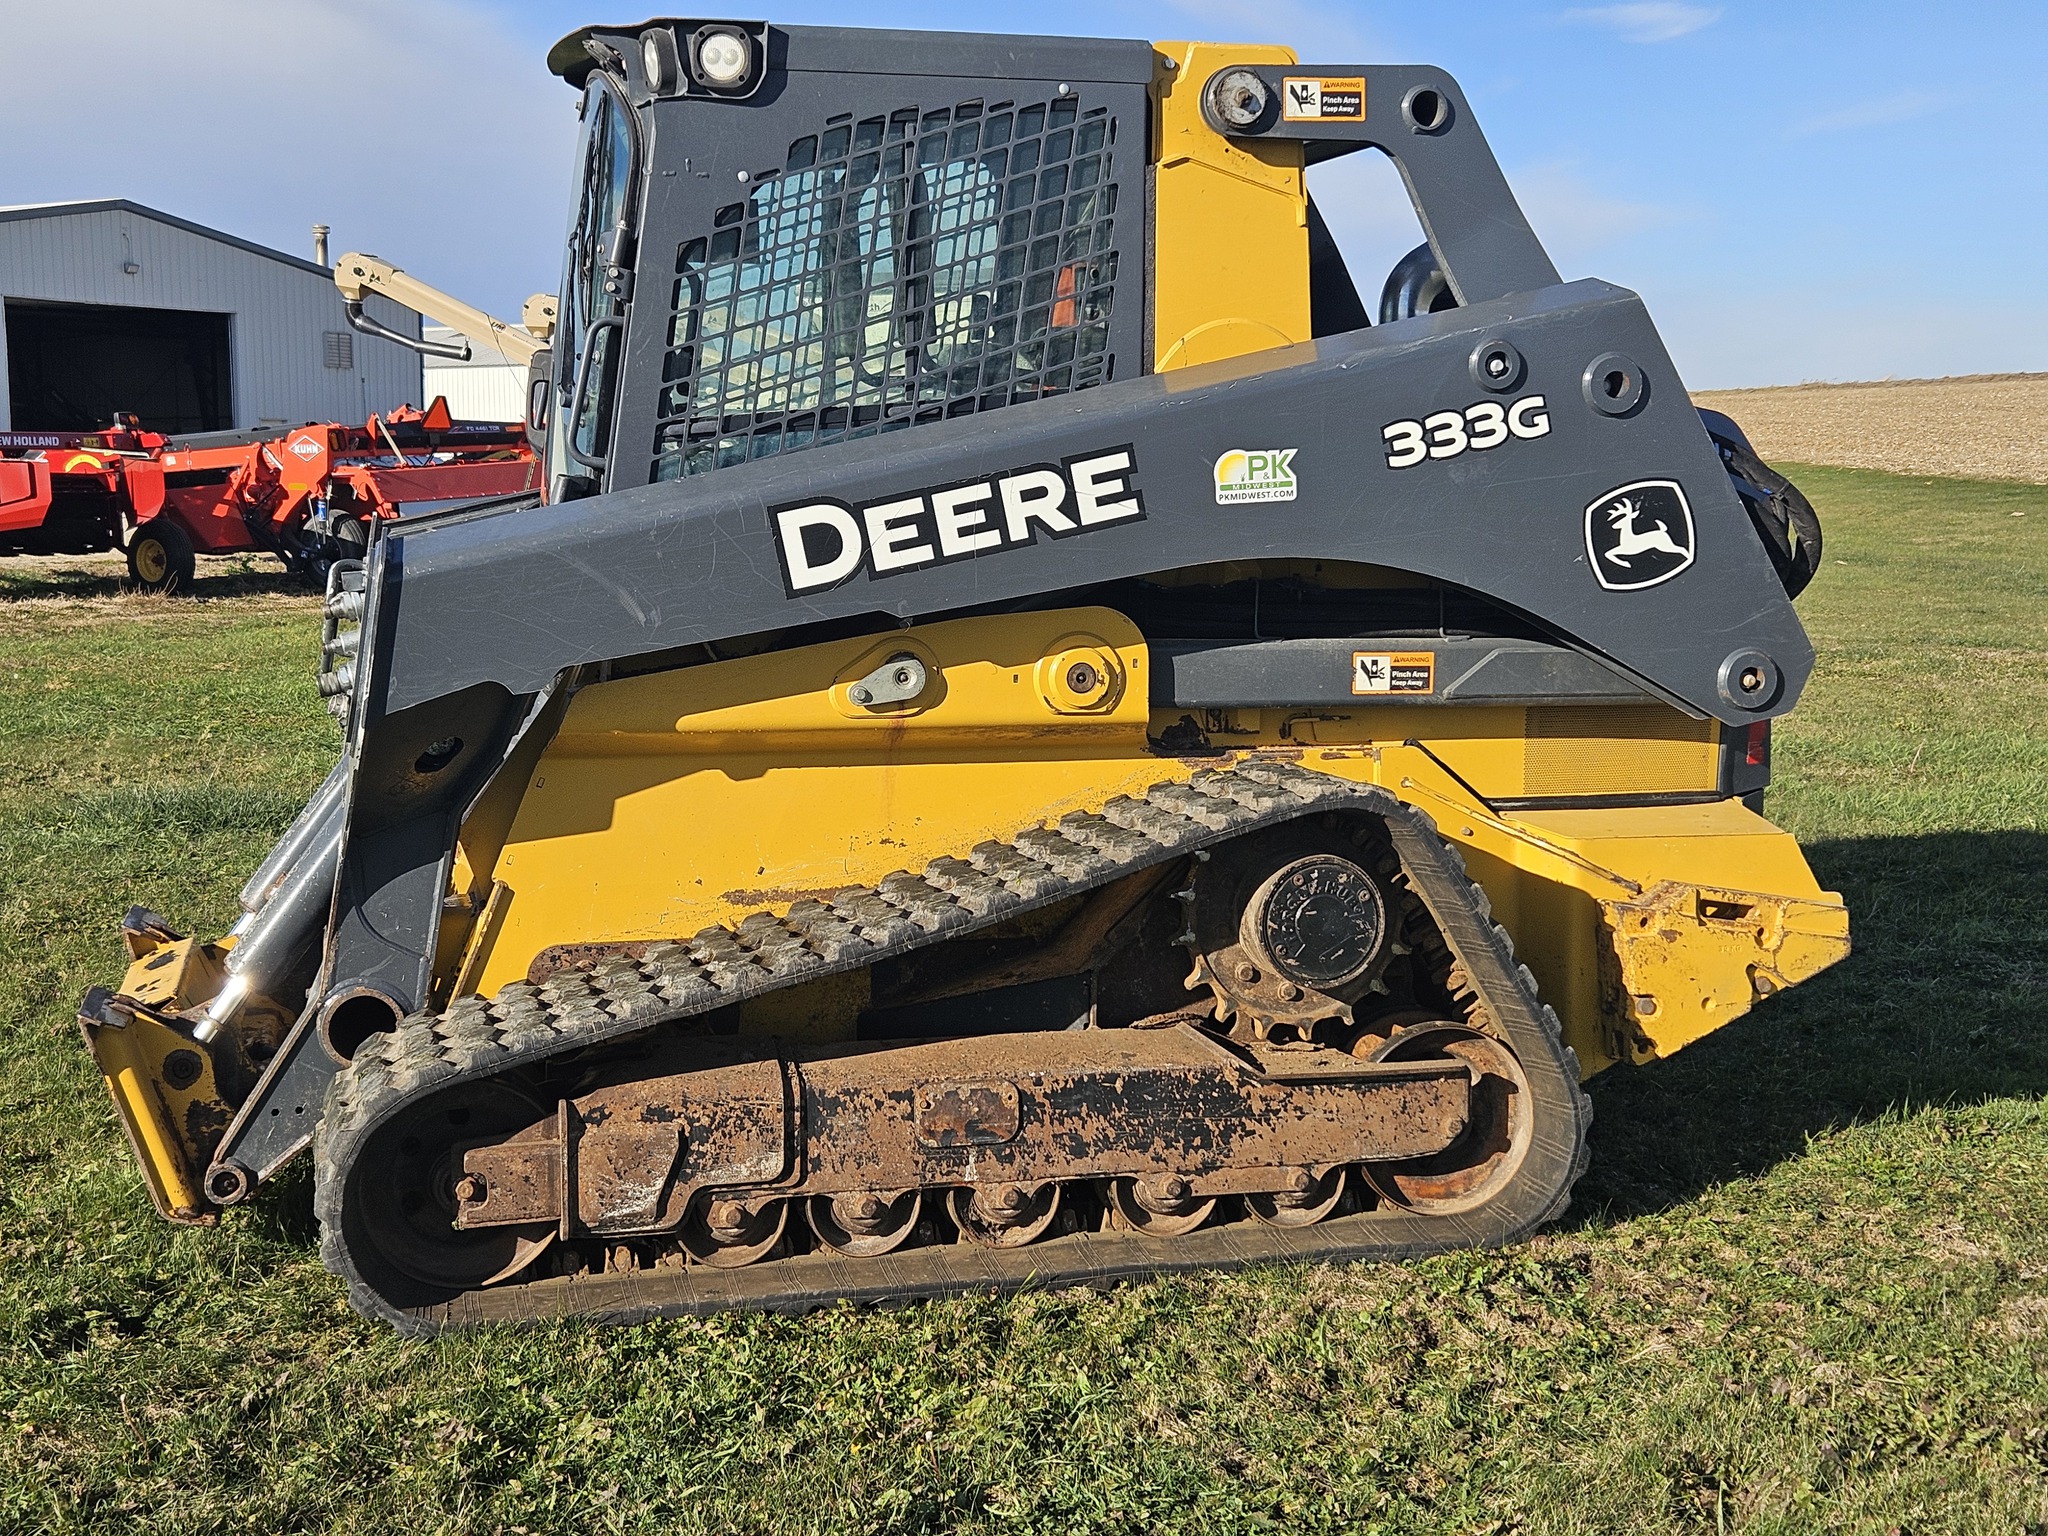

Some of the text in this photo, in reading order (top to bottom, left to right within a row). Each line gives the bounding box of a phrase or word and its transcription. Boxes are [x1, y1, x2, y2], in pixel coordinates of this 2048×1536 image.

[1322, 96, 1360, 104] Pinch Area
[1322, 105, 1354, 113] Keep Away
[1382, 394, 1551, 469] 333G
[13, 436, 60, 446] HOLLAND
[295, 444, 319, 454] KUHN
[1232, 482, 1281, 490] MIDWEST
[1219, 490, 1294, 501] PKMIDWEST.COM
[776, 451, 1140, 591] DEERE
